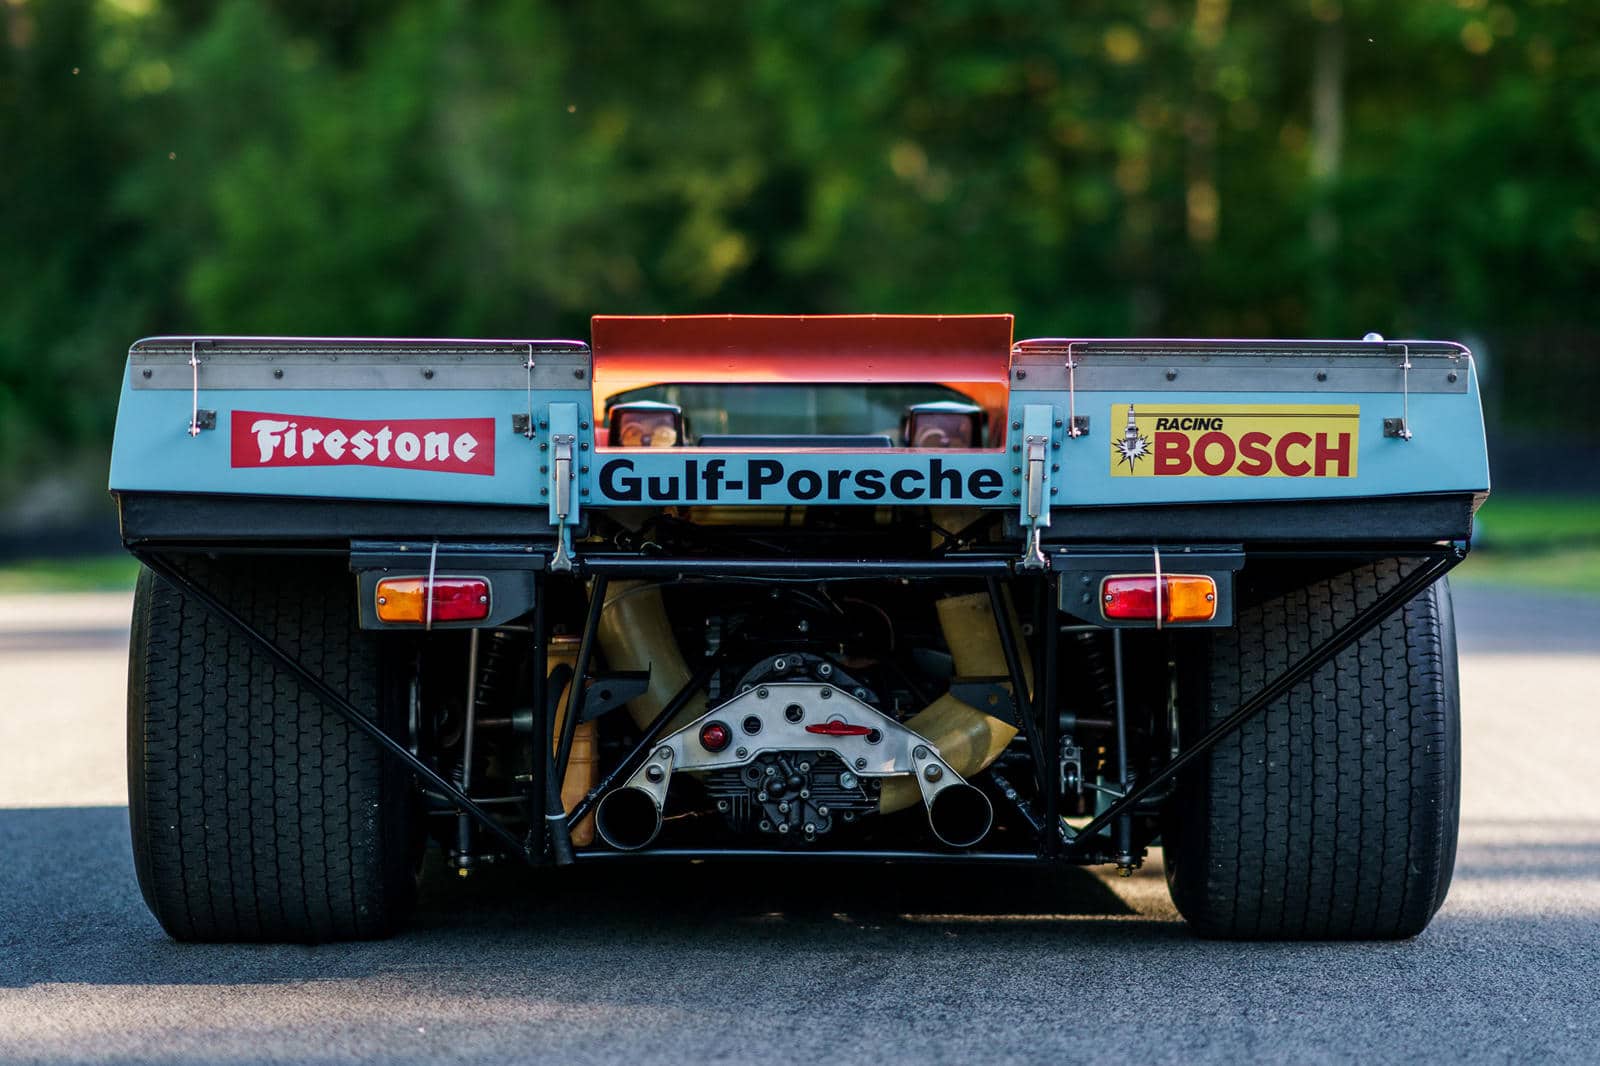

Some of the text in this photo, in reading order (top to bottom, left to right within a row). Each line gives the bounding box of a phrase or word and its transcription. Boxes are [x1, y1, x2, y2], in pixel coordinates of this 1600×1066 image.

[251, 419, 479, 463] Firestone
[1156, 418, 1223, 431] RACING
[1153, 431, 1350, 477] BOSCH
[598, 458, 1004, 502] Gulf-Porsche
